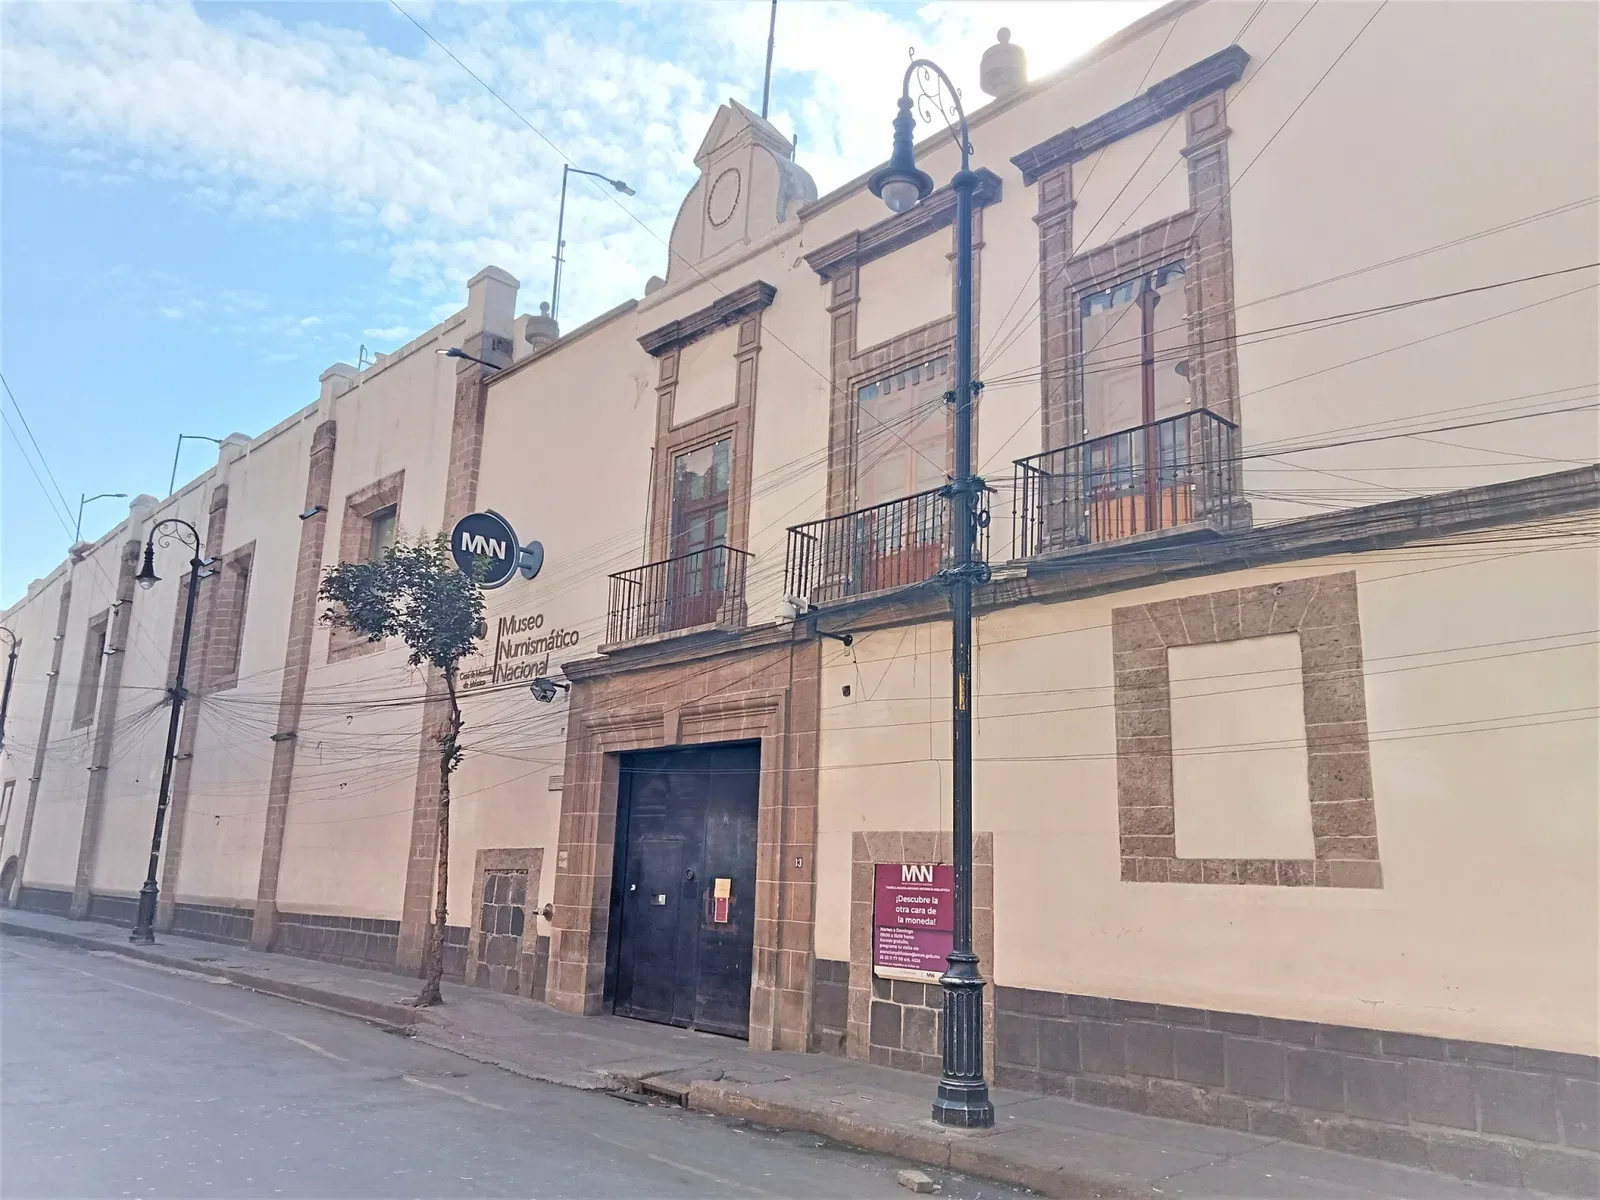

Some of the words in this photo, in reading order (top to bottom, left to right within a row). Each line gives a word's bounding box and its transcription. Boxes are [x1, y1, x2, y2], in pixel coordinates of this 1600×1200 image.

[501, 613, 544, 637] Museo
[500, 629, 579, 661] Numismático
[495, 653, 550, 684] Nacional
[795, 858, 803, 868] 13
[901, 864, 933, 882] MNN
[896, 894, 931, 904] ¡Descubre
[931, 896, 939, 905] la
[895, 906, 910, 914] otra
[910, 907, 926, 915] cara
[927, 906, 937, 915] de
[897, 915, 904, 924] la
[905, 917, 936, 926] moneda!
